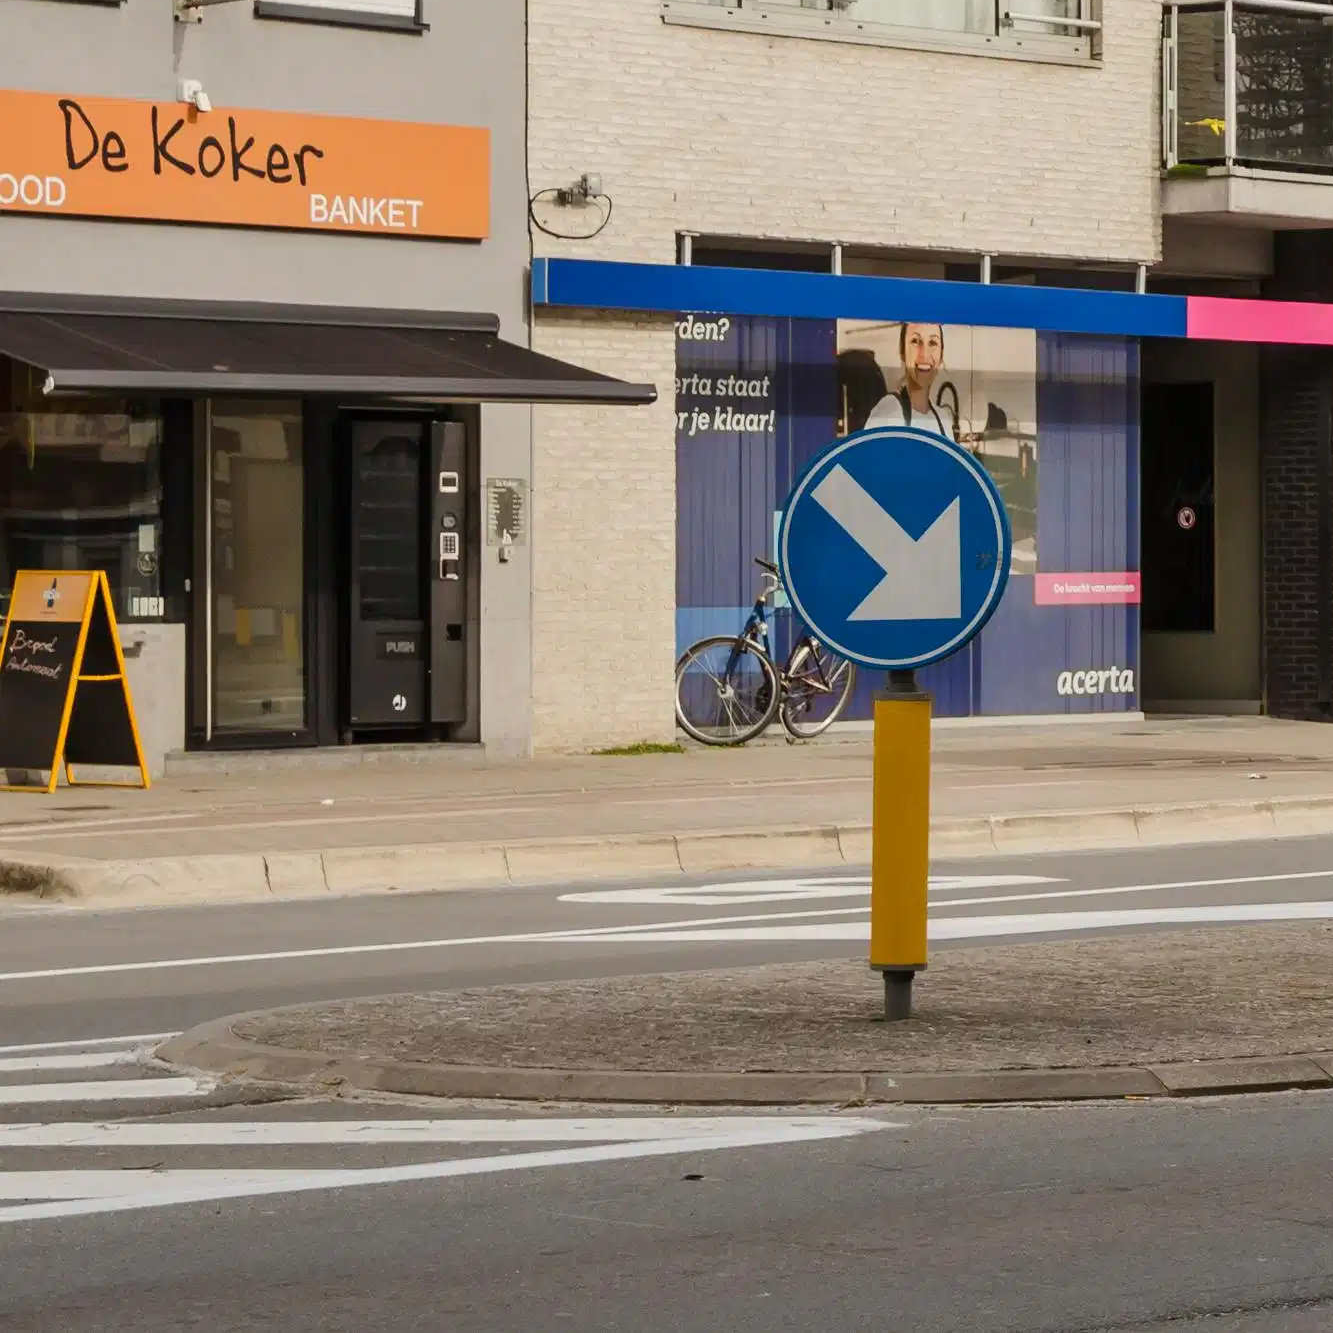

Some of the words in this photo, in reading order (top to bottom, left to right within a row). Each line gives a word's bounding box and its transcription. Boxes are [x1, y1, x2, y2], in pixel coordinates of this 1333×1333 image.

[59, 99, 129, 172] De
[151, 106, 324, 186] Koker
[310, 194, 424, 228] BANKET
[715, 374, 770, 397] staat
[688, 406, 710, 436] je
[713, 406, 775, 432] klaar!
[386, 642, 415, 653] PUSH
[1057, 666, 1134, 695] acerta
